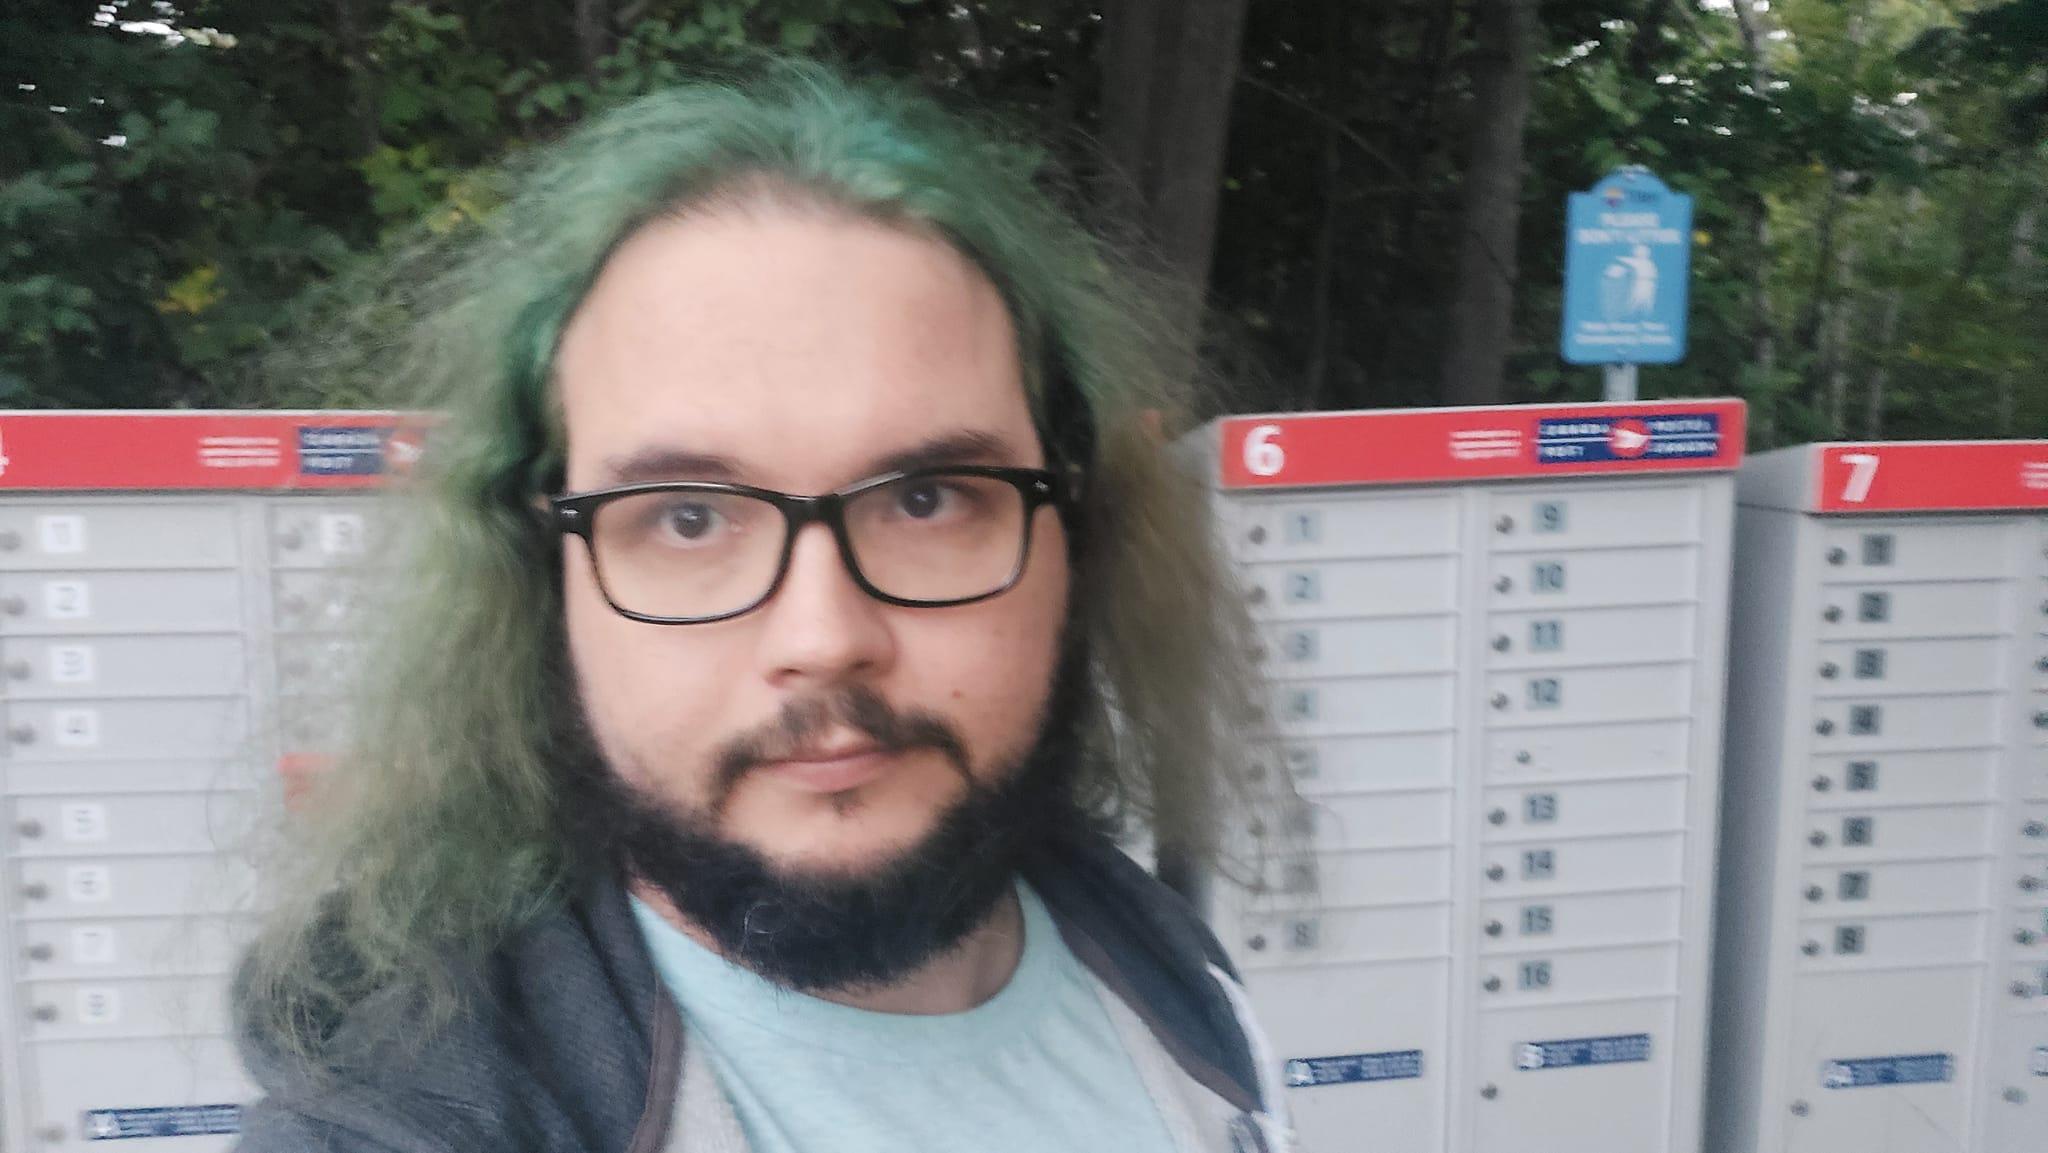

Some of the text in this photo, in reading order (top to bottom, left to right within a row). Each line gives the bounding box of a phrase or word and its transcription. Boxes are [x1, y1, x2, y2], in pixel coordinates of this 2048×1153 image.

[1243, 425, 1285, 476] 6
[1840, 453, 1880, 503] 7
[1542, 504, 1560, 531] 9
[1295, 574, 1313, 600] 2
[1535, 563, 1564, 589] 10
[1532, 622, 1560, 648] 11
[1530, 678, 1560, 703] 12
[1528, 795, 1556, 820] 13
[1526, 850, 1553, 875] 14
[1525, 906, 1552, 932] 15
[1523, 963, 1552, 988] 16
